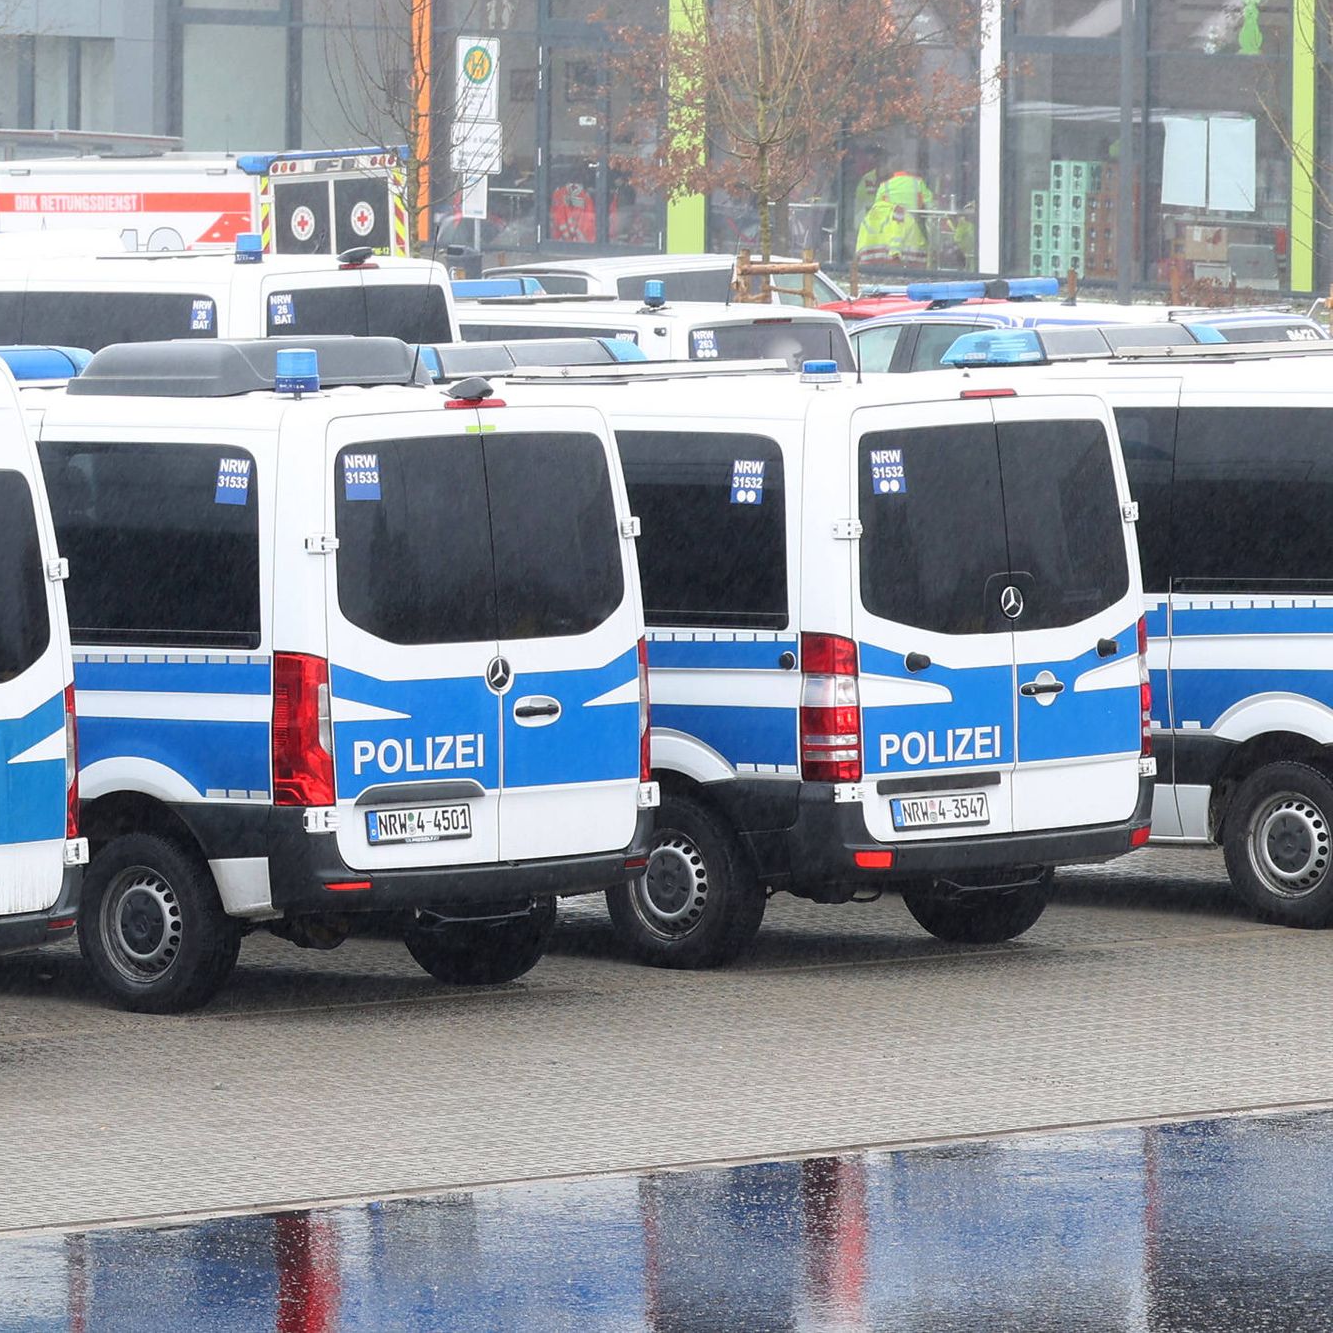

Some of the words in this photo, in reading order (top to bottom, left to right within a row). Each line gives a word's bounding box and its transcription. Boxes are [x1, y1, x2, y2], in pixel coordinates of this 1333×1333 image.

[15, 195, 37, 211] DRK
[40, 195, 138, 211] RETTUNGSDIENST
[193, 300, 213, 310] NRW
[270, 295, 292, 305] NRW
[196, 311, 206, 319] 26
[277, 305, 288, 314] 26
[192, 320, 210, 330] BAT
[274, 315, 292, 325] BAT
[615, 333, 636, 342] NRW
[693, 330, 714, 340] NRW
[344, 455, 376, 469] NRW
[871, 450, 902, 464] NRW
[219, 459, 251, 474] NRW
[734, 461, 764, 474] NRW
[872, 466, 904, 479] 31532
[217, 476, 248, 489] 31533
[345, 472, 379, 484] 31533
[733, 477, 763, 489] 31532
[880, 725, 1001, 767] POLIZEI
[354, 733, 484, 775] POLIZEI
[902, 800, 929, 823] NRW
[938, 797, 985, 820] 4-3547
[378, 814, 407, 836] NRW
[417, 808, 469, 832] 4-4501
